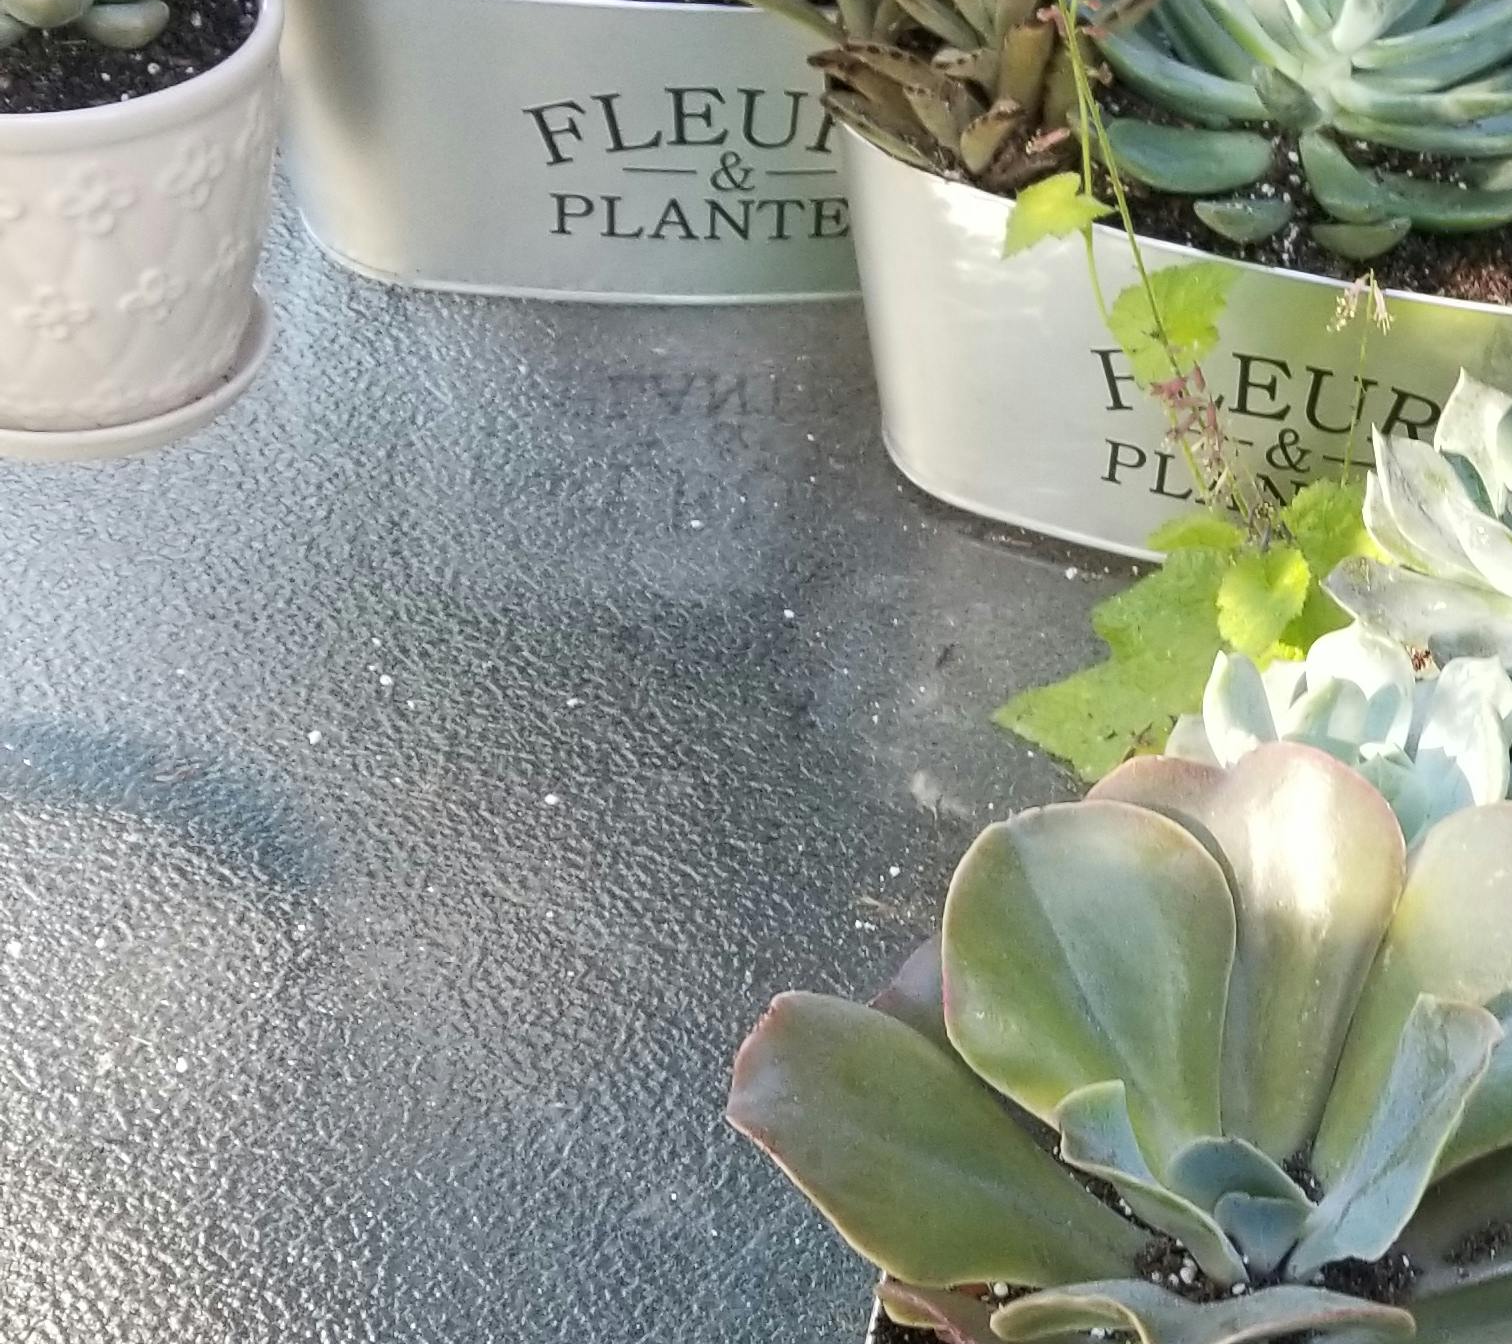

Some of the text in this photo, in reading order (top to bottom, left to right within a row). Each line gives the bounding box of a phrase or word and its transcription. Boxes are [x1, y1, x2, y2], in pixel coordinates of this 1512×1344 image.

[710, 151, 756, 191] &
[1090, 348, 1442, 441] FEUR
[1265, 428, 1313, 473] &
